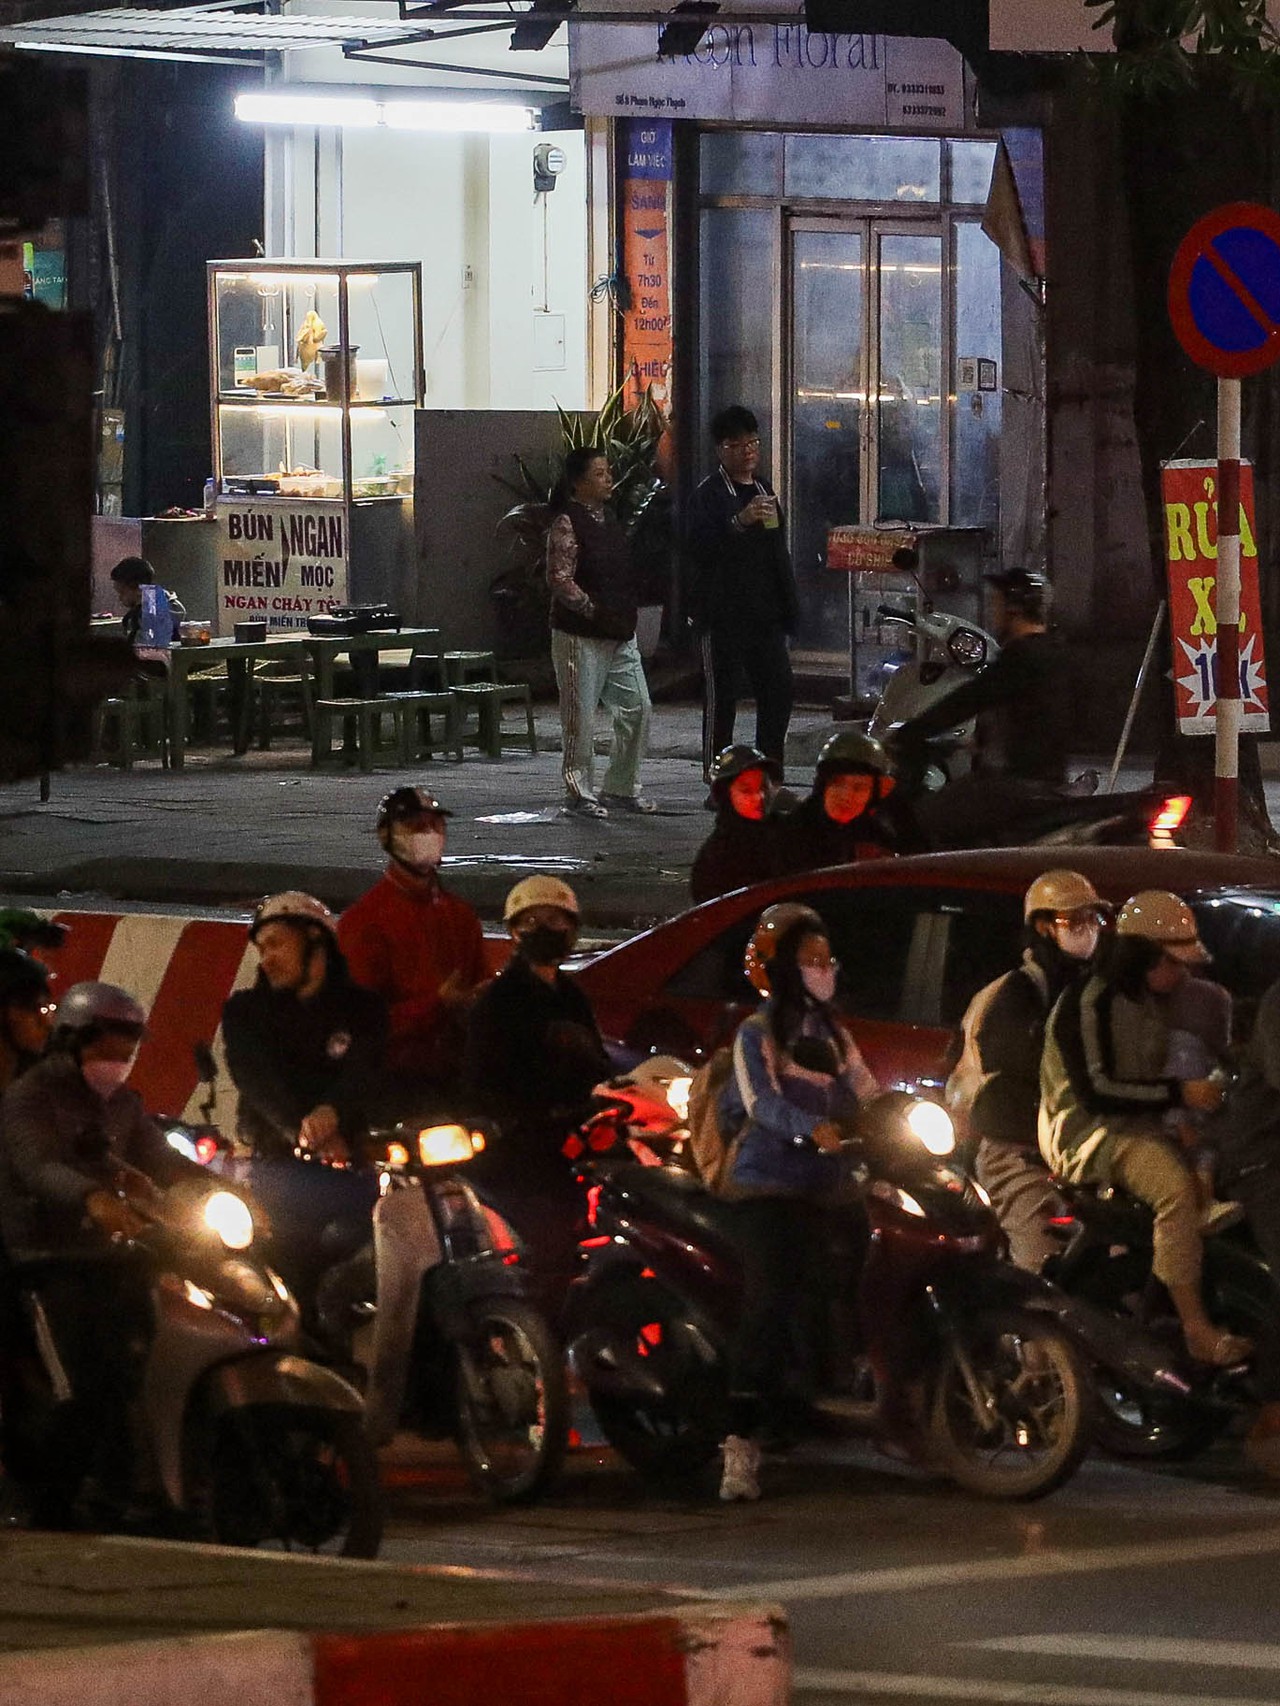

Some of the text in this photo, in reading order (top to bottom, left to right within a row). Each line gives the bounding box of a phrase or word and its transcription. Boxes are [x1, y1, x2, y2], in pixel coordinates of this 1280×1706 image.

[657, 21, 757, 66] oon
[638, 274, 661, 287] 7h30
[229, 509, 343, 558] BÚN NGAN
[223, 552, 335, 592] MIẾN MỌC
[224, 595, 268, 609] NGAN
[272, 594, 313, 612] CHÁY
